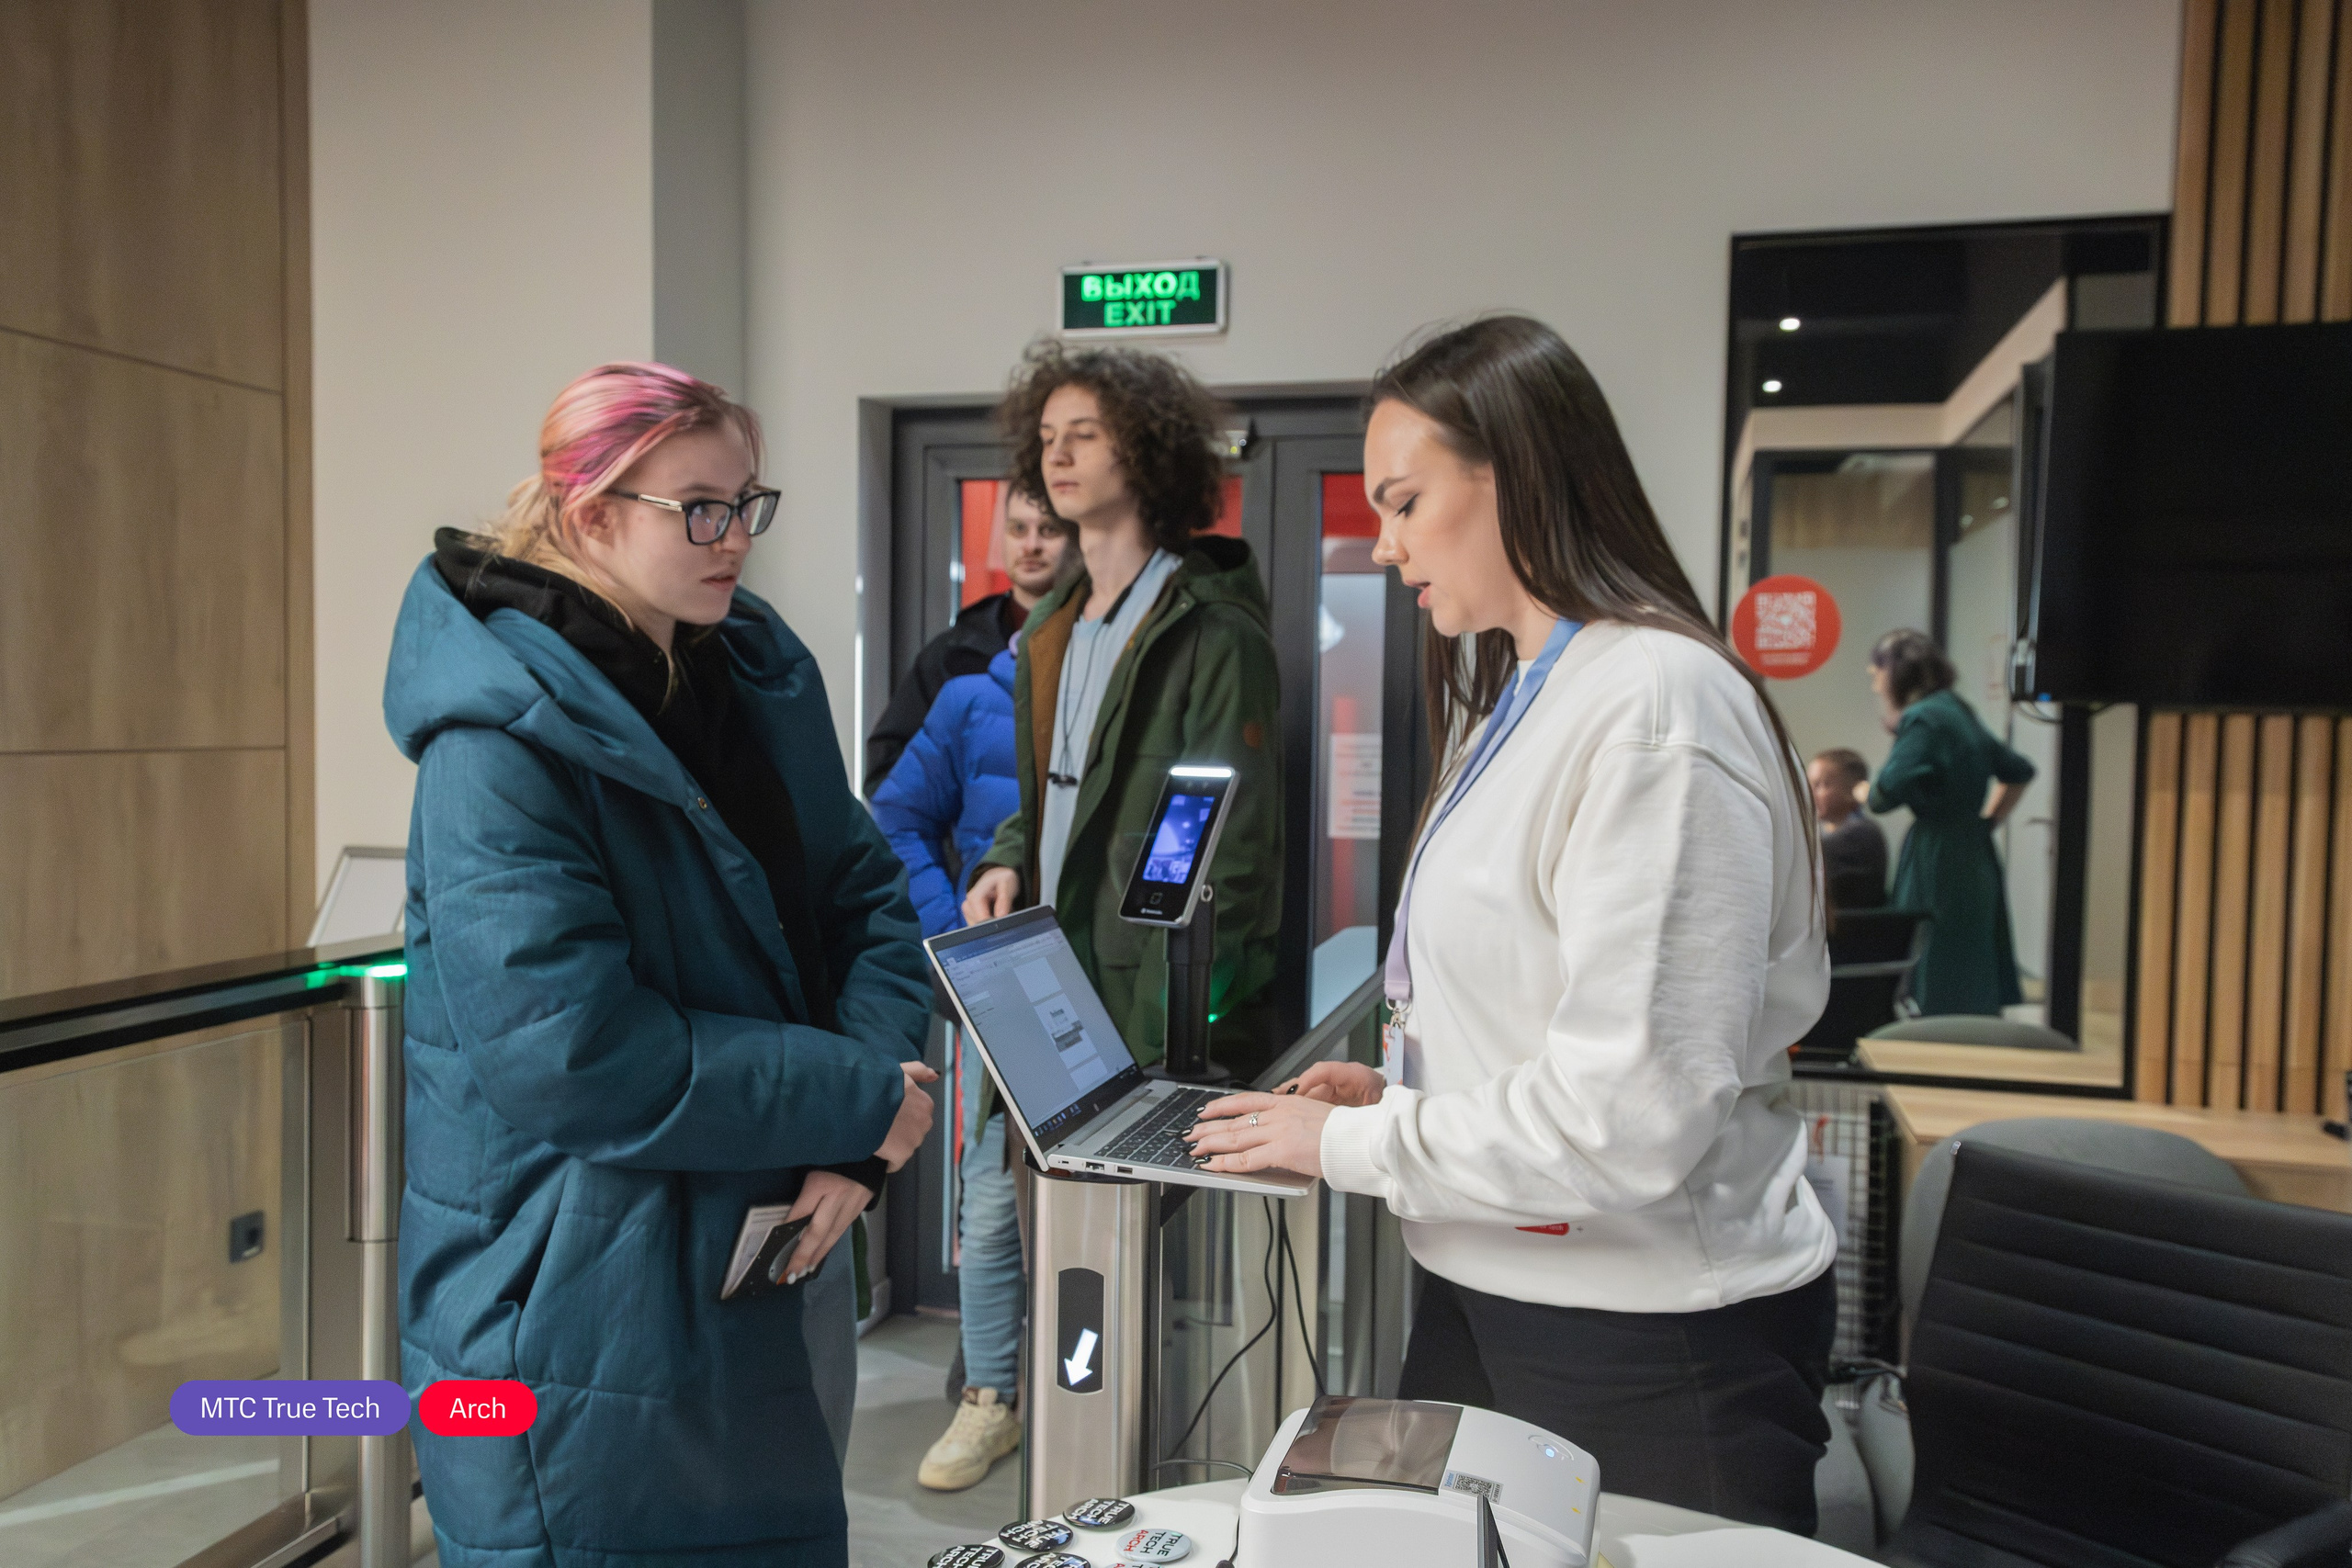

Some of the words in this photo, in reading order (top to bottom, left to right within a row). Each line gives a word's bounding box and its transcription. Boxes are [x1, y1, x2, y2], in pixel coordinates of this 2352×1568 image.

[1081, 271, 1200, 301] ВЫХОД
[1103, 299, 1177, 327] EXIT
[1068, 1498, 1099, 1520] ARCH
[1084, 1500, 1115, 1522] TECH
[1097, 1503, 1130, 1524] TRUE
[1000, 1519, 1044, 1538] ARCH
[1012, 1523, 1058, 1542] TECH
[1024, 1529, 1071, 1549] TRUE
[1124, 1529, 1148, 1551] ARCH
[1140, 1532, 1167, 1553] TECH
[1157, 1534, 1183, 1556] TRUE
